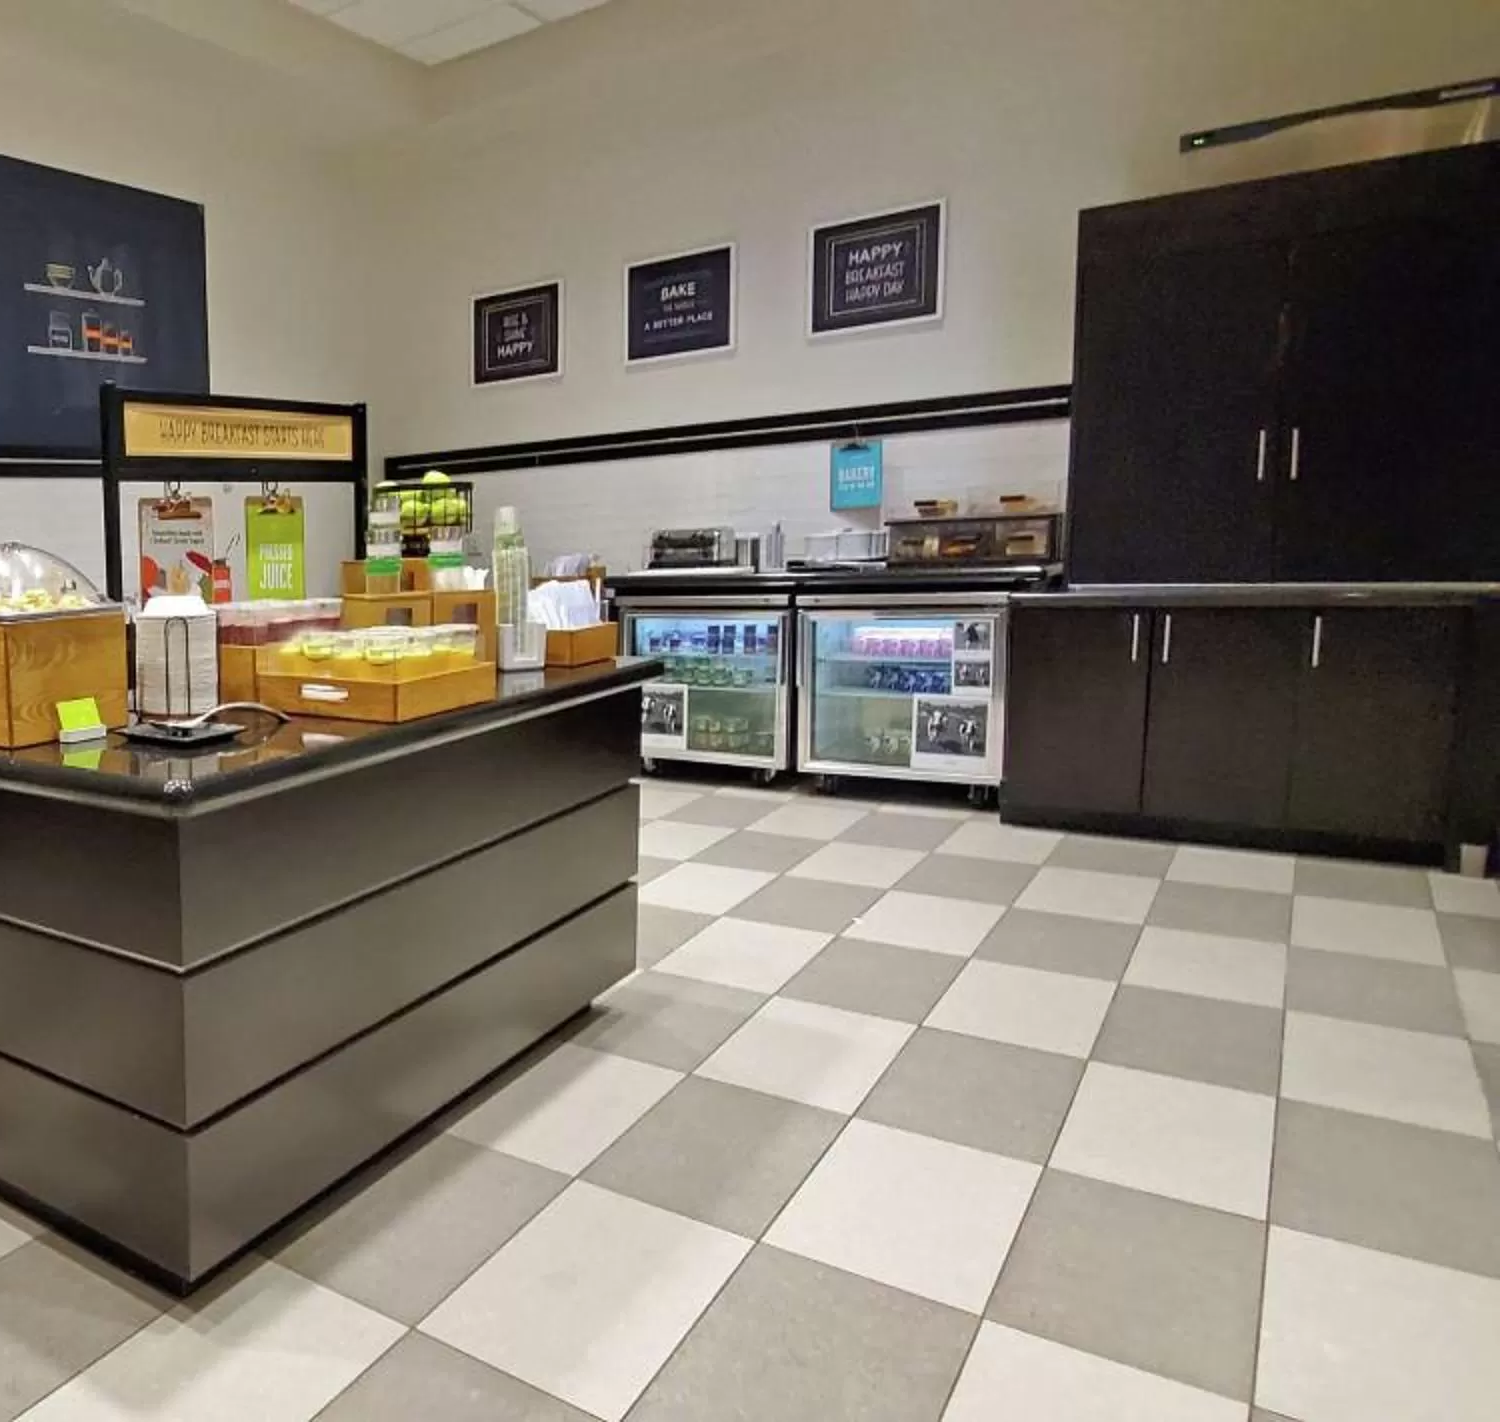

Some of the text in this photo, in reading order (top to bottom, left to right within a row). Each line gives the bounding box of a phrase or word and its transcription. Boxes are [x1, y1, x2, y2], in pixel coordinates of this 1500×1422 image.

[848, 242, 903, 267] HAPPY
[845, 261, 905, 286] BREAKFAST
[661, 281, 696, 302] BAKE
[845, 279, 905, 304] HAPPY DAY
[643, 321, 651, 331] A
[686, 311, 713, 324] PLACE
[497, 341, 533, 360] HAPPY
[159, 418, 197, 444] HAPPY
[200, 420, 260, 446] BREAKFAST
[262, 423, 300, 448] STARTS
[259, 563, 293, 590] JUICE
